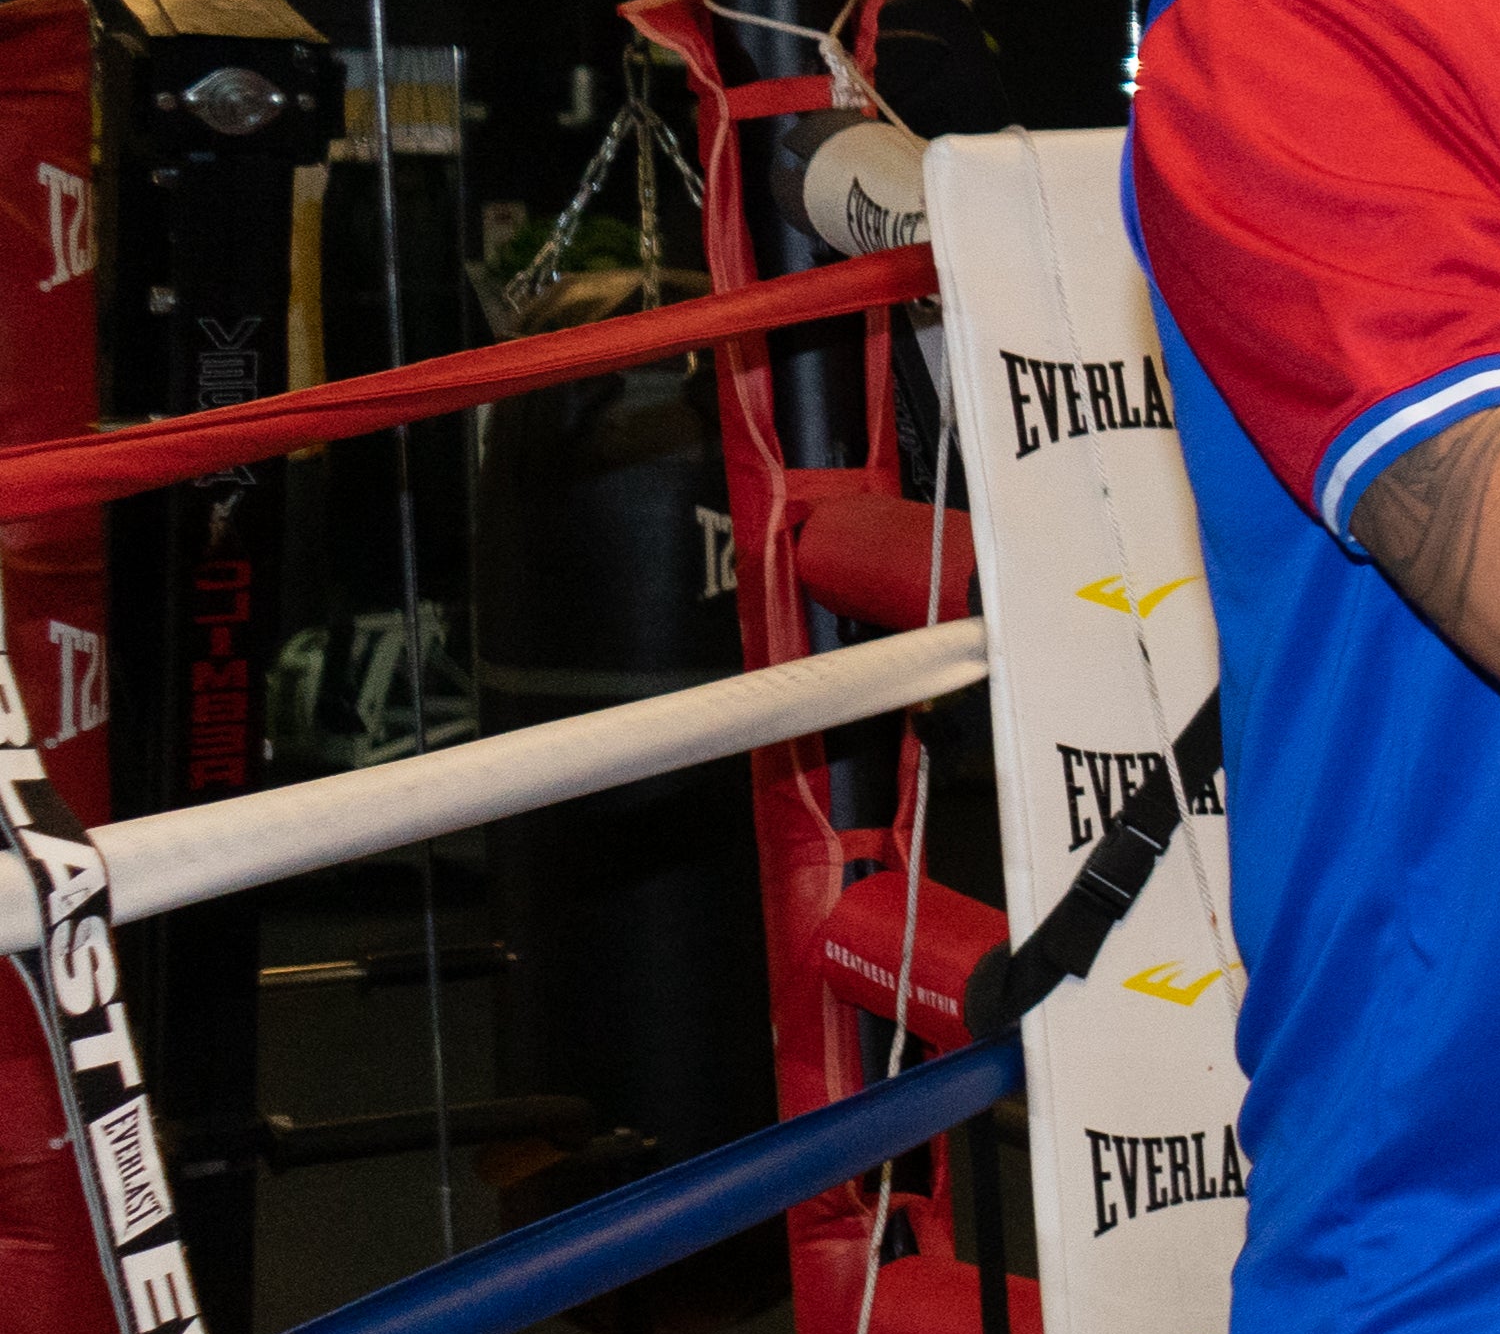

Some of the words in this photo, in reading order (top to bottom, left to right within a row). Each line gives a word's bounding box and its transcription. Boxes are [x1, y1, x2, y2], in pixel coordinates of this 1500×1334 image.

[1000, 349, 1174, 460] EVERLA
[824, 939, 895, 992] GREATNESS
[103, 1105, 163, 1230] EVERLAST
[1084, 1124, 1246, 1238] EVERLA
